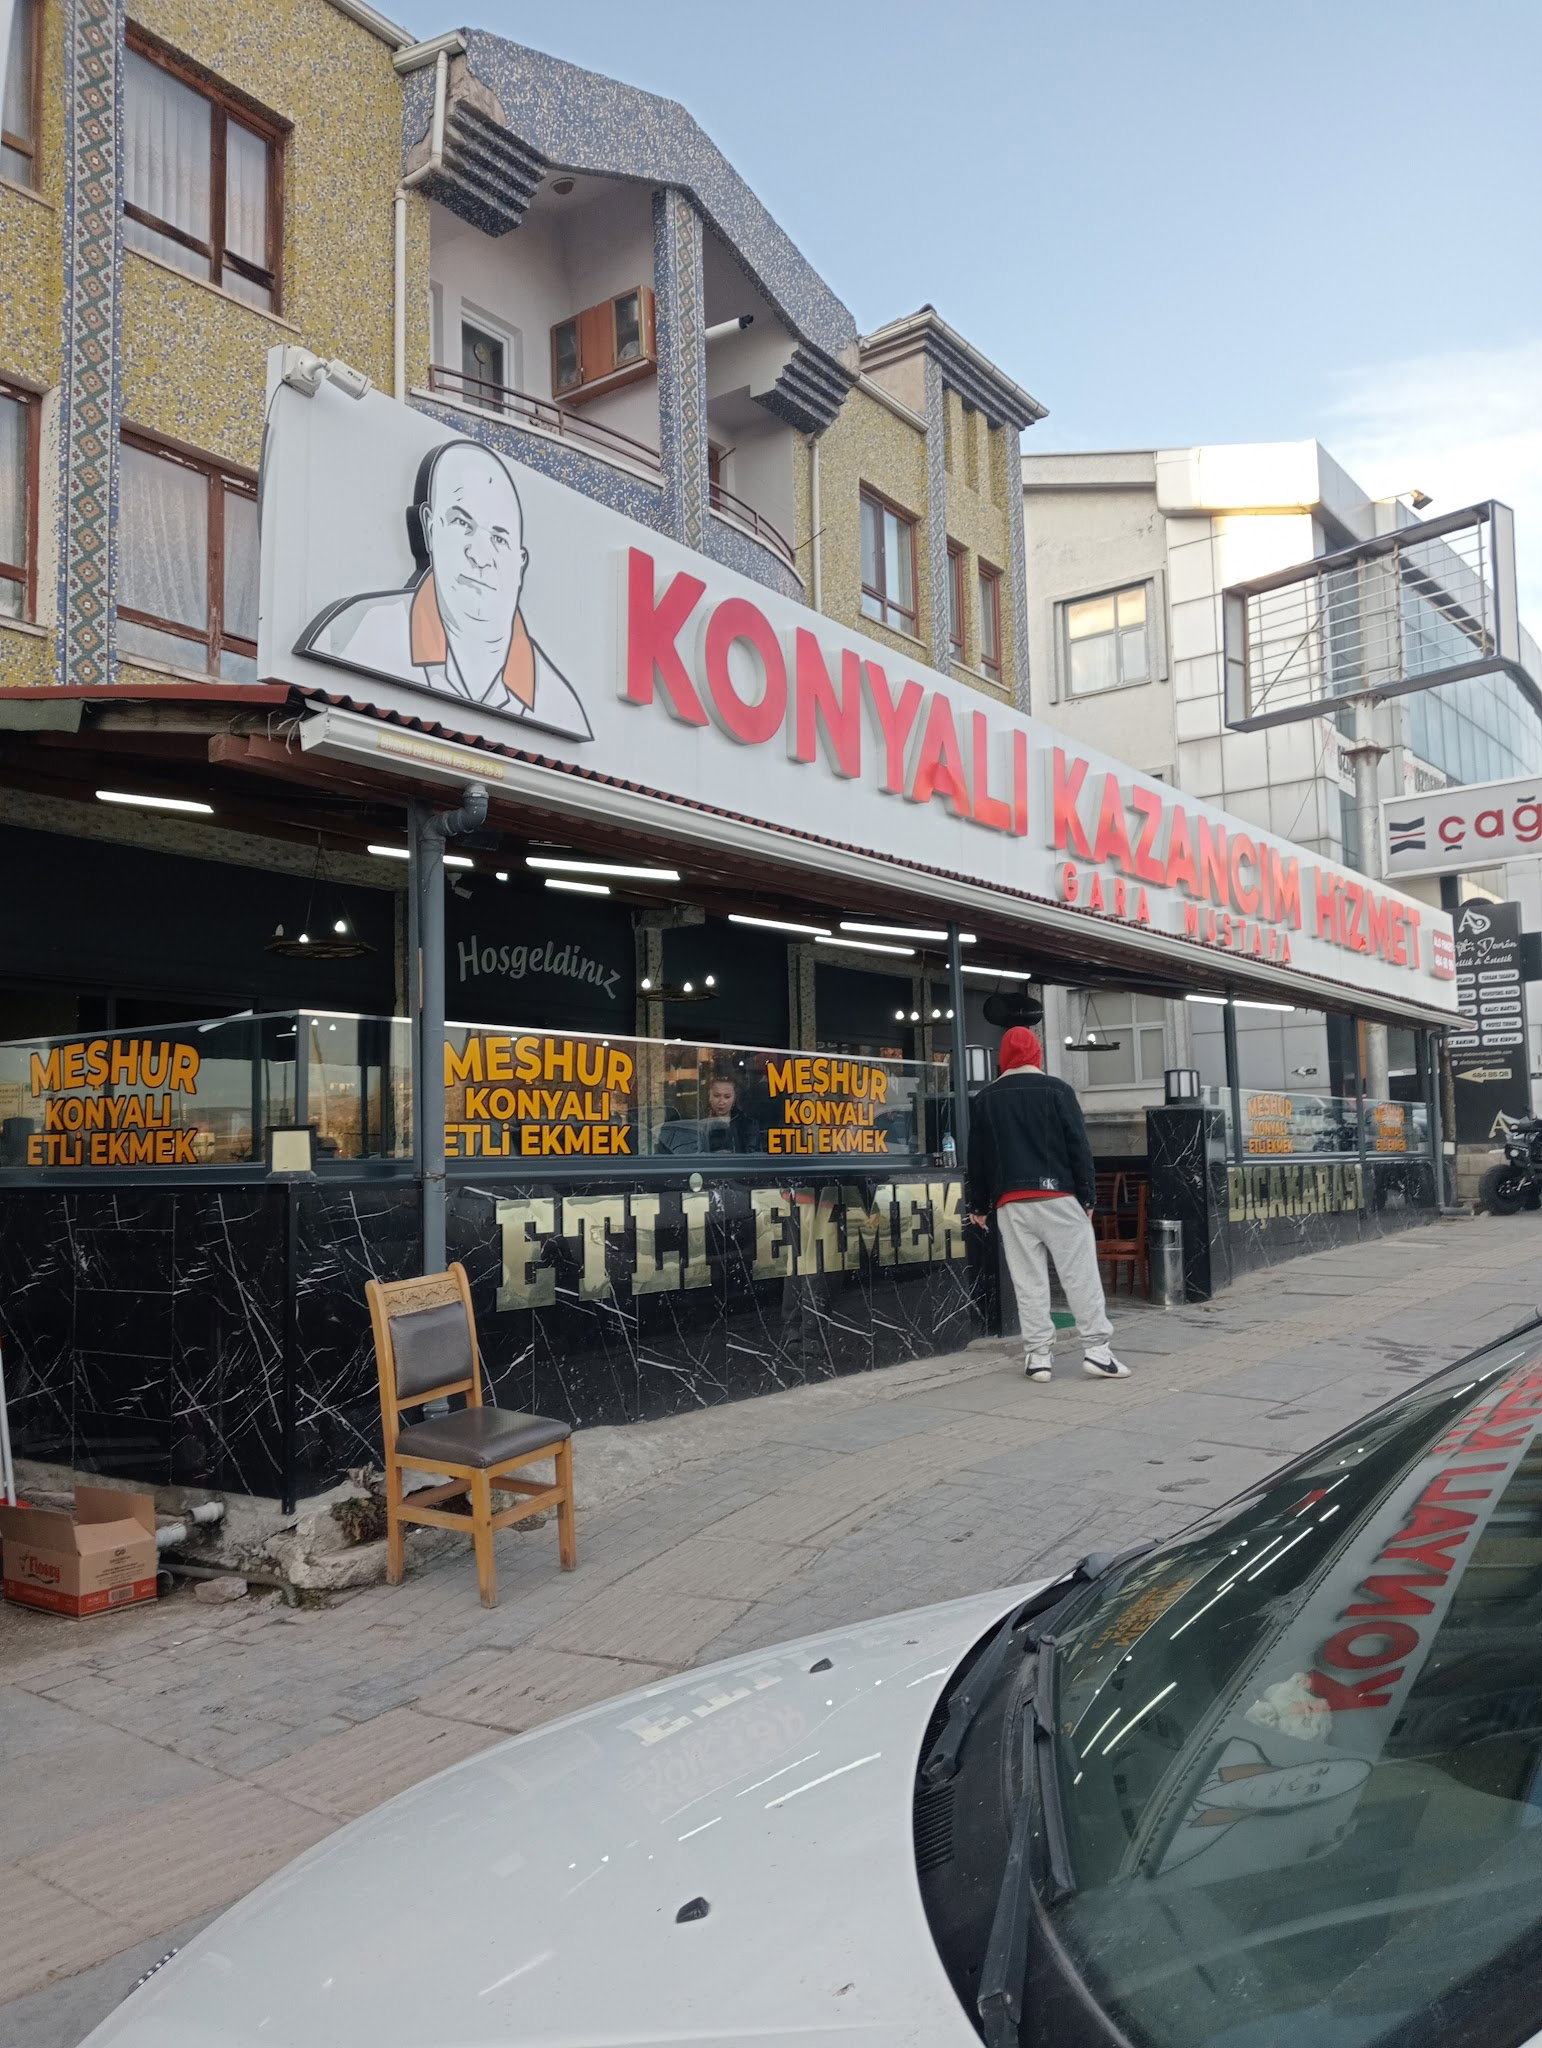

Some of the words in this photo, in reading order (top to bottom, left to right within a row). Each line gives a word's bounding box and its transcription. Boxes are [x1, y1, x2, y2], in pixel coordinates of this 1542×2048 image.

[620, 546, 1028, 836] KONYALI
[1048, 746, 1302, 931] KAZANCIM
[1313, 866, 1421, 969] HİZMET
[1059, 861, 1151, 924] GARA
[1182, 901, 1293, 964] MUSTAFA
[30, 1039, 200, 1098] MEŞHUR
[444, 1035, 635, 1095] MEŞHUR
[766, 1057, 889, 1104] MEŞHUR
[45, 1093, 172, 1131] KONYALI
[465, 1087, 611, 1122] KONYALI
[784, 1098, 875, 1127] KONYALI
[90, 1128, 199, 1165] EKMEK
[520, 1124, 632, 1156] EKMEK
[818, 1128, 889, 1154] EKMEK
[496, 1171, 712, 1312] ETLİ
[750, 1182, 966, 1280] EKMEK
